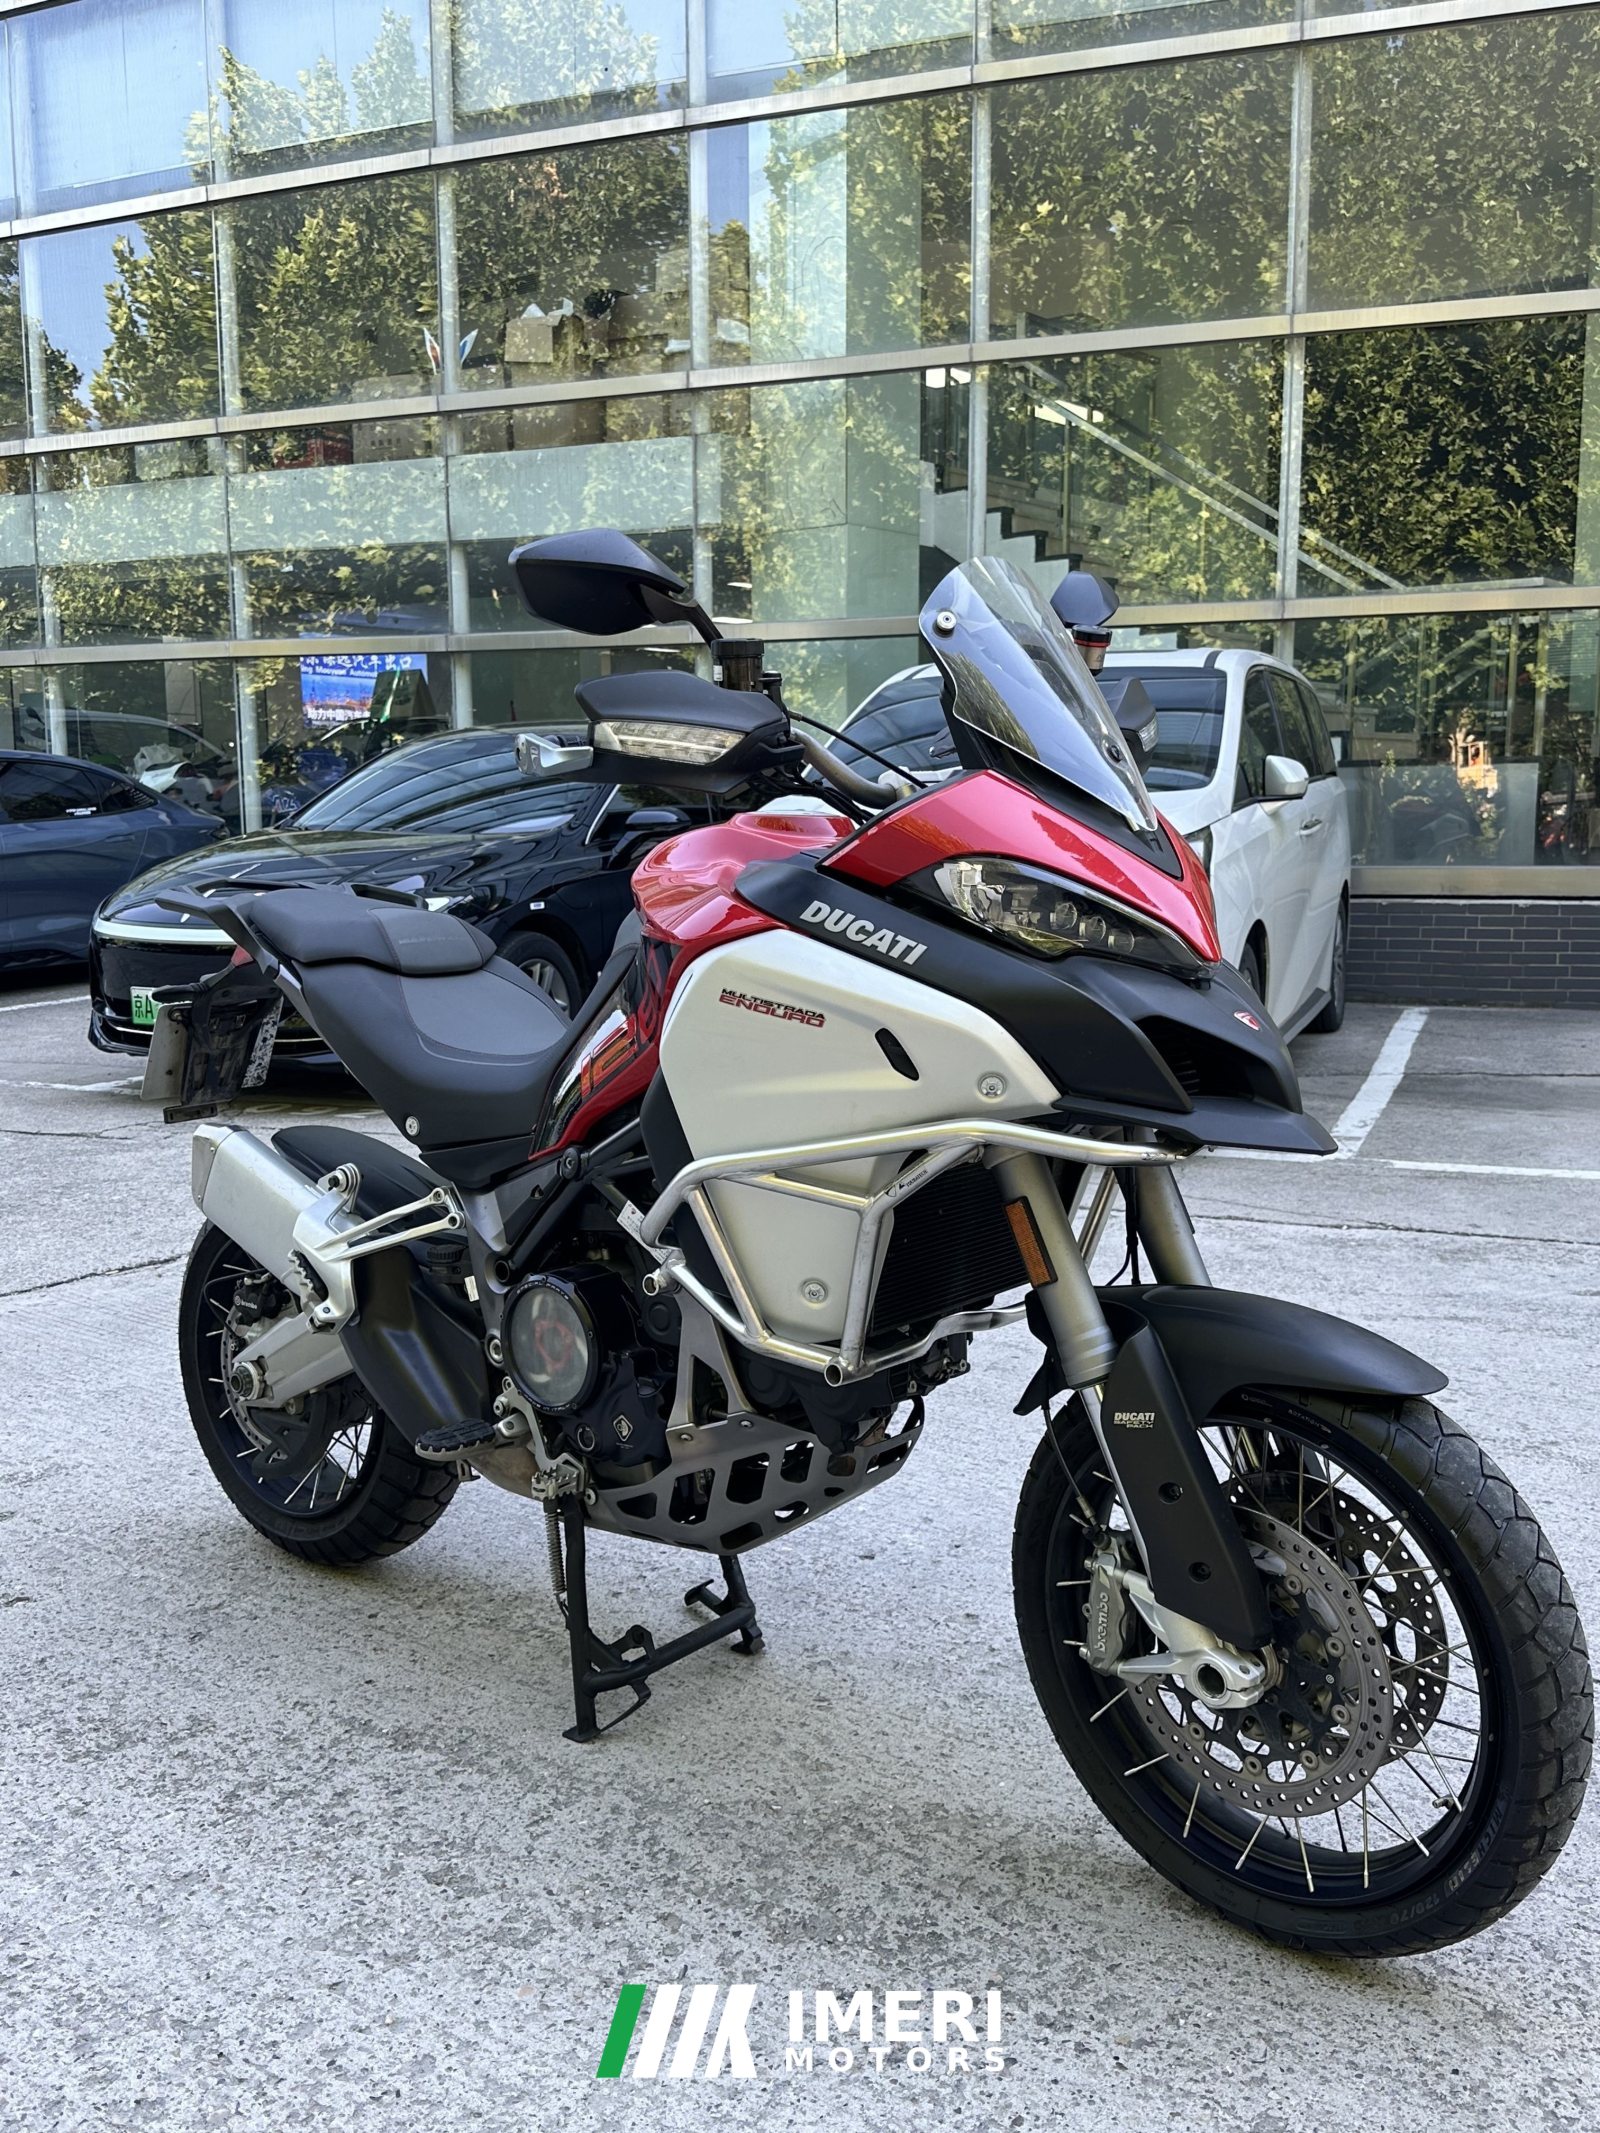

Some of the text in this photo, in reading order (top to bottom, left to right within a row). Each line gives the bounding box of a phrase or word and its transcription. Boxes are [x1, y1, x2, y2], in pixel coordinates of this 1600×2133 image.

[799, 899, 929, 966] DUCATI
[718, 994, 826, 1029] ENDURO
[721, 988, 826, 1020] MULTISTRADA
[1113, 1412, 1156, 1421] DUCATI
[1094, 1591, 1109, 1654] brembo
